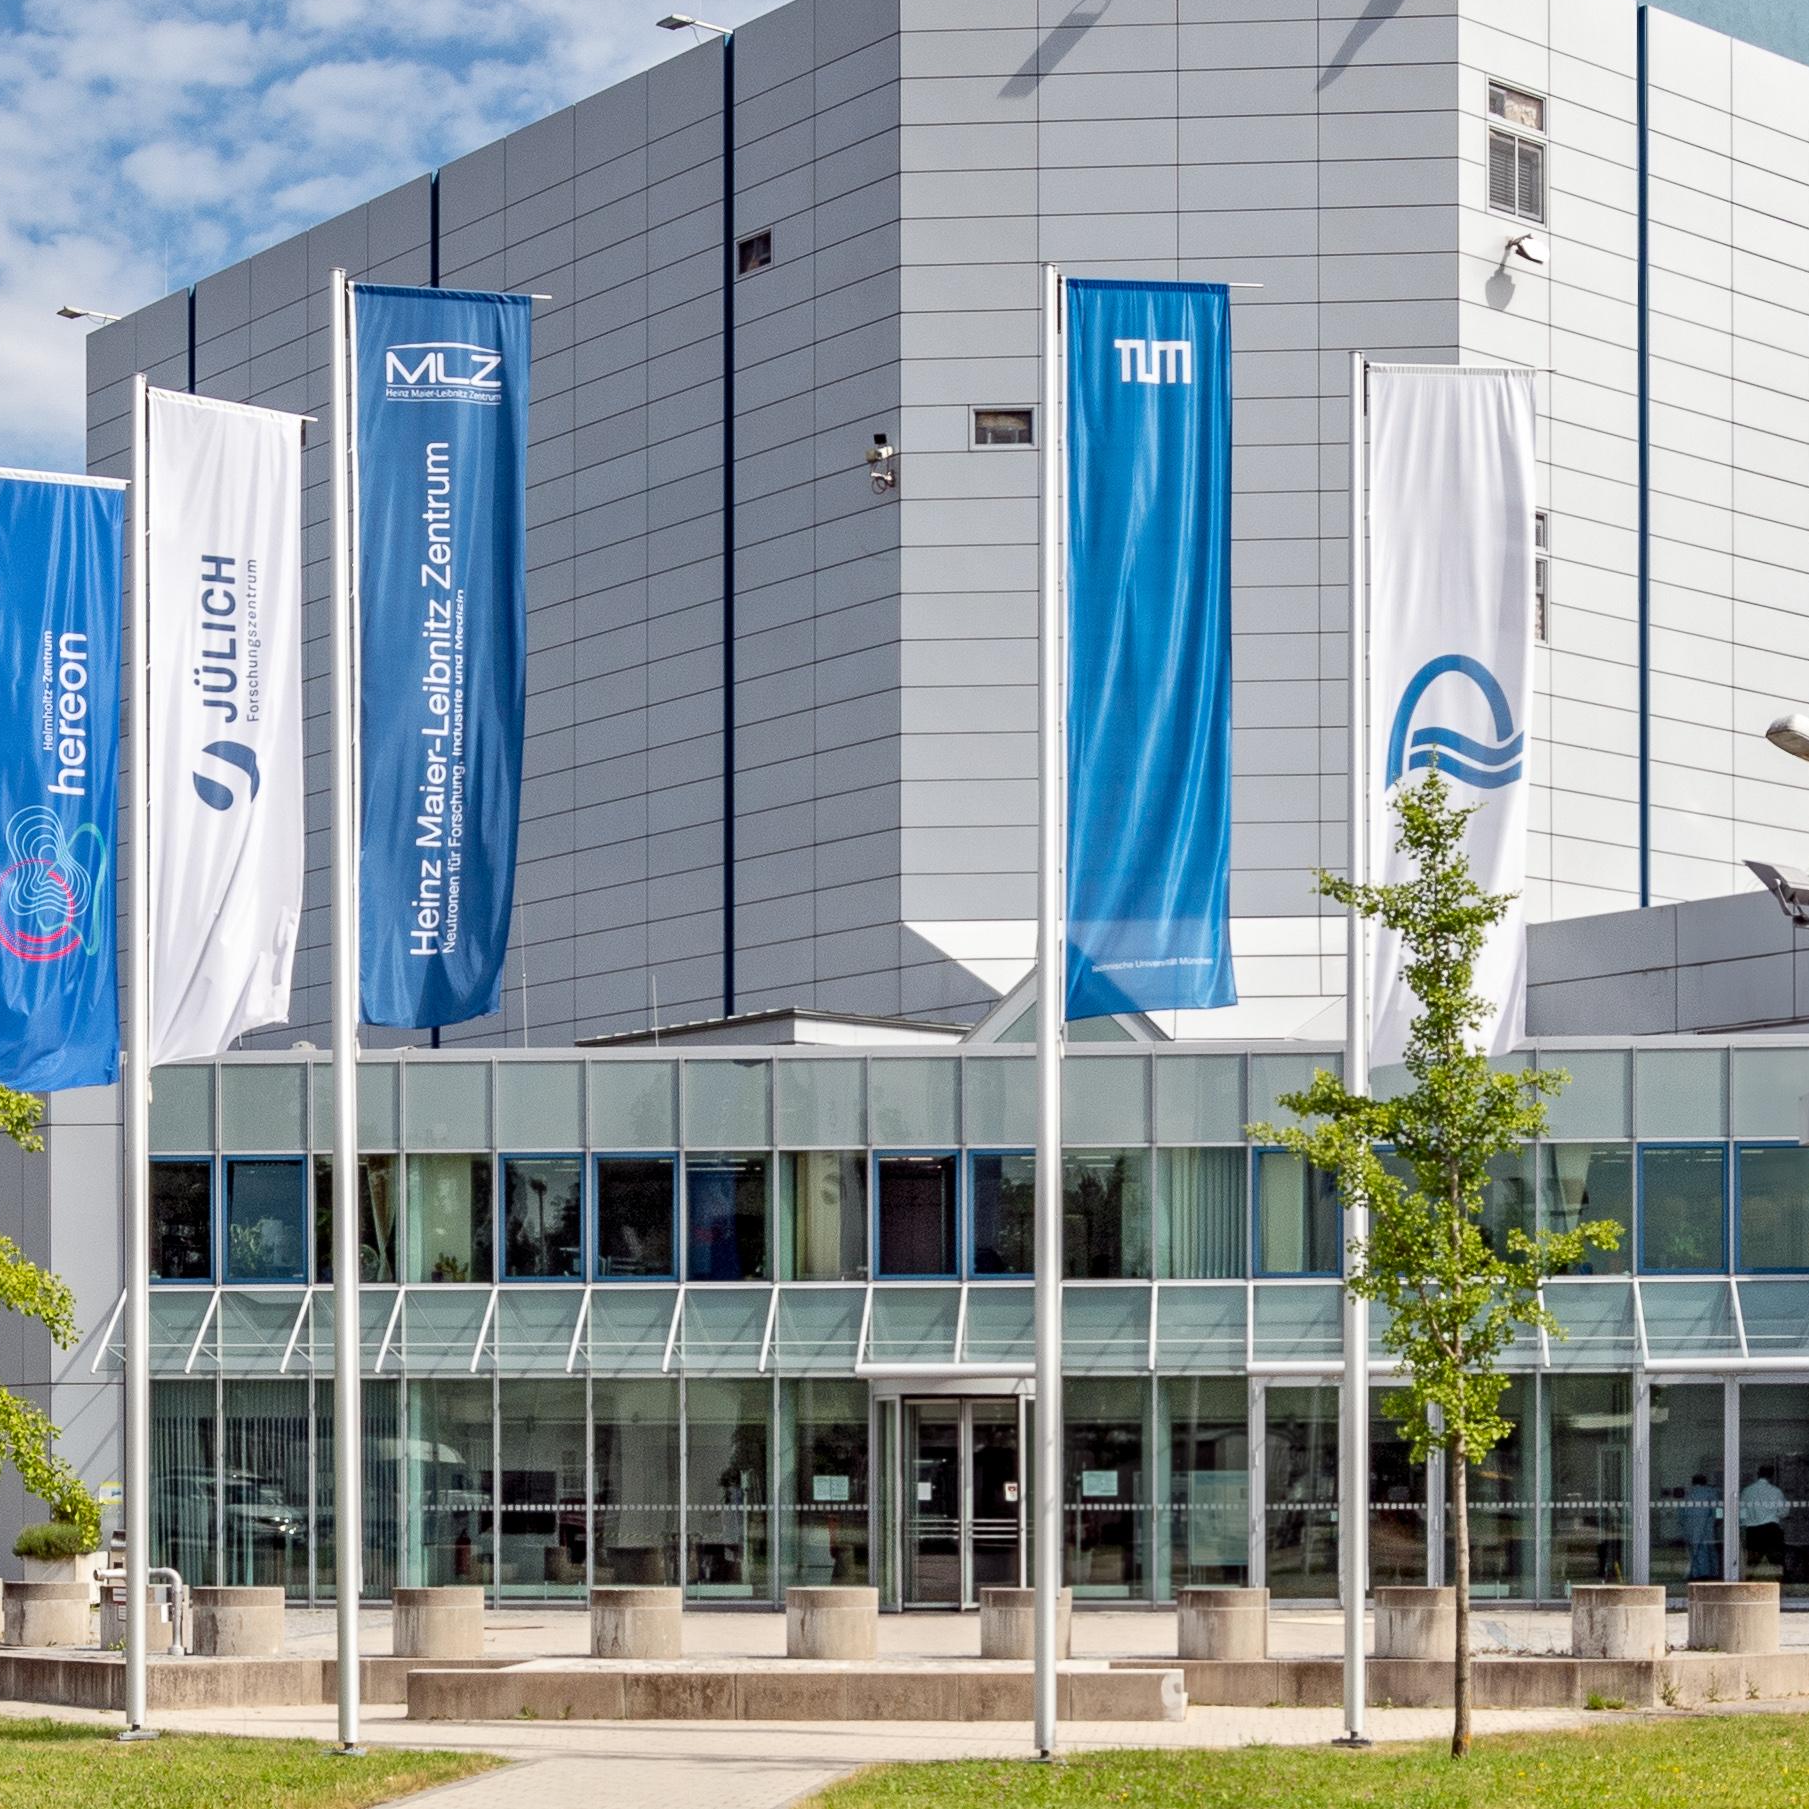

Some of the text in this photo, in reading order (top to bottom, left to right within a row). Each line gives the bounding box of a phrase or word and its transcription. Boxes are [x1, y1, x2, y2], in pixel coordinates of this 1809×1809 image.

[386, 351, 502, 387] MLZ
[386, 388, 502, 402] Heinz Maier-Leibnitz Zentrum
[1114, 339, 1192, 385] TUM
[43, 630, 54, 751] Helmholtz-Zentrum
[47, 632, 88, 796] hereon
[193, 555, 238, 724] JÜLICH
[246, 559, 262, 722] Forschungszentrum
[409, 442, 452, 956] Heinz Maier-Leibnitz Zentrum
[442, 589, 466, 954] Neutronen für Forschung, Industrie und Medizin
